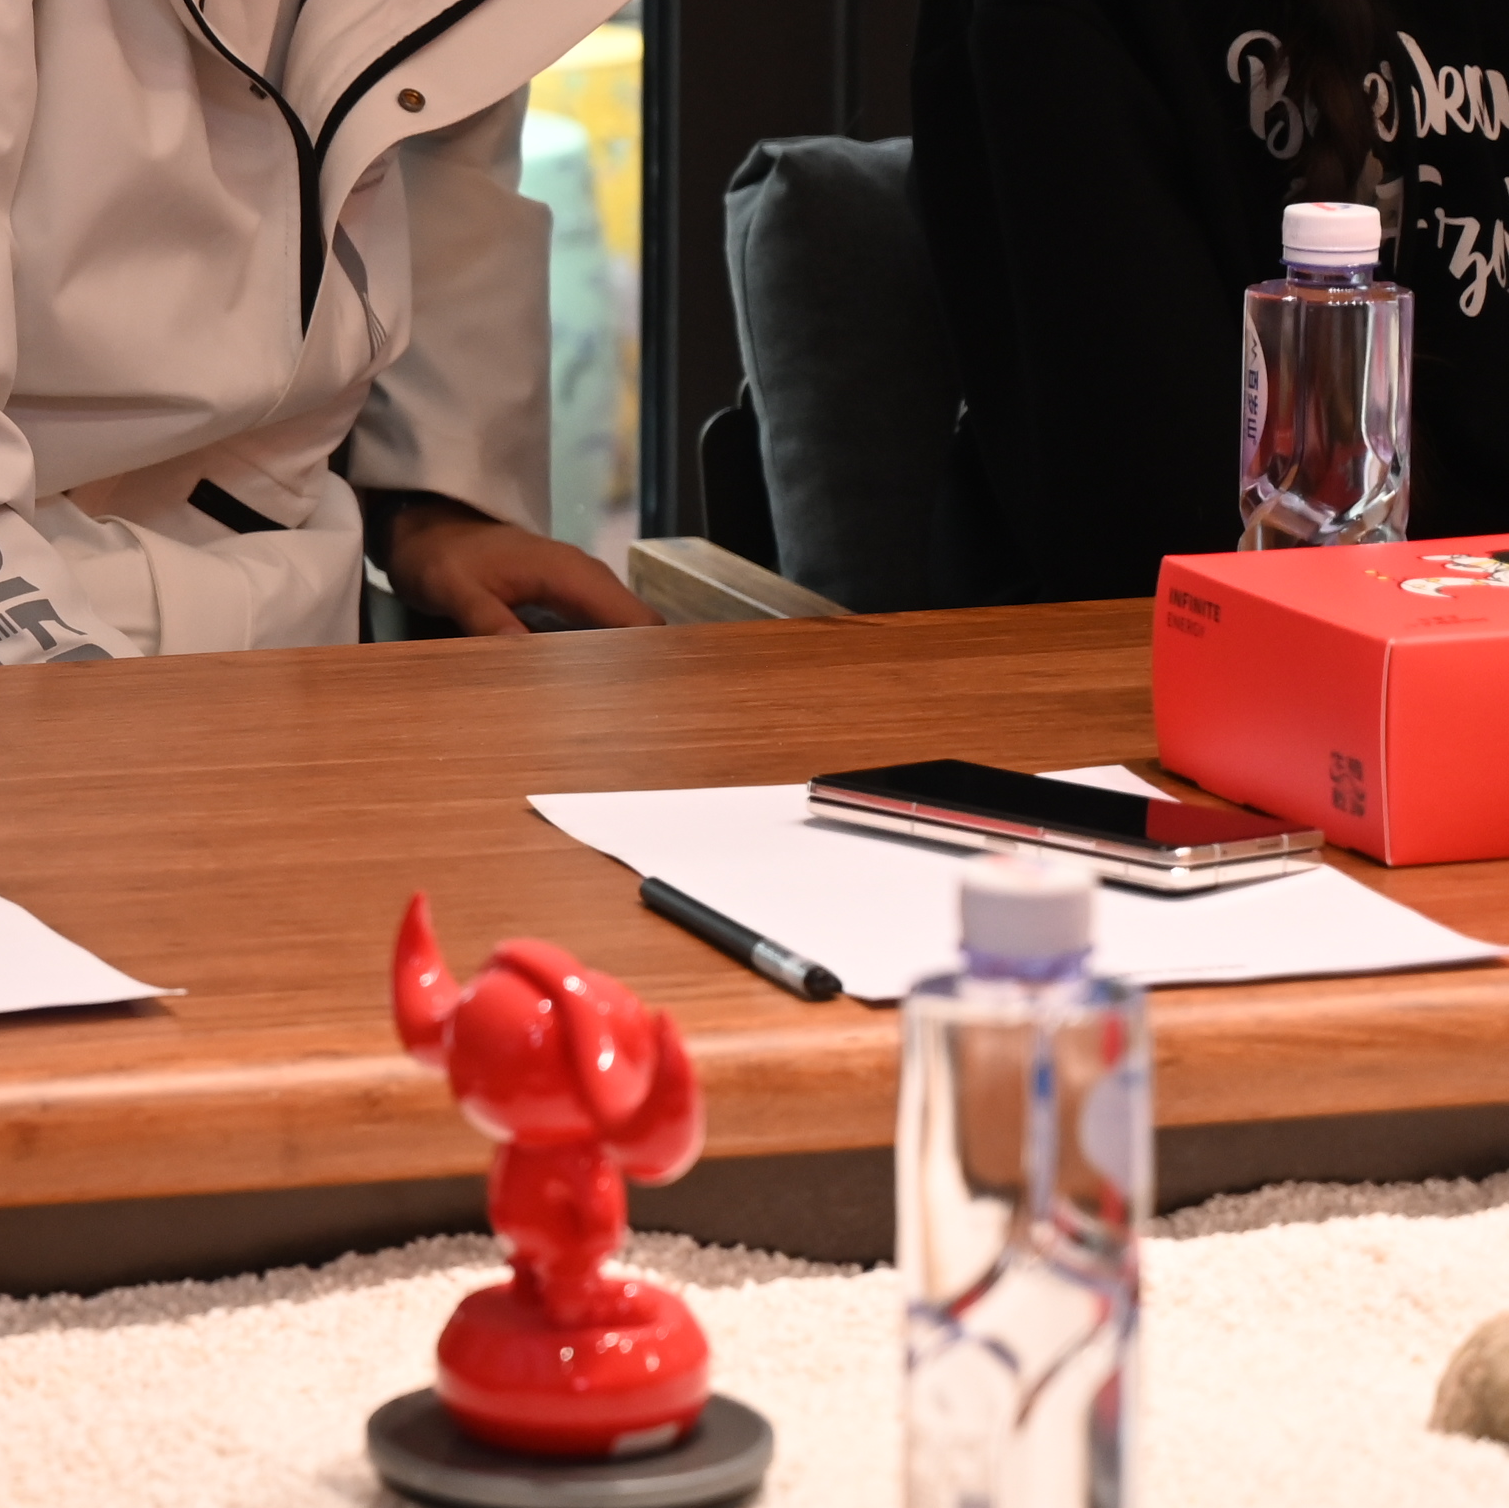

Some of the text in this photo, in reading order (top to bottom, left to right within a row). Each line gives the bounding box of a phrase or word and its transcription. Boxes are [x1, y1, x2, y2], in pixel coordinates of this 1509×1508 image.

[1247, 369, 1259, 439] 百岁山
[1168, 587, 1221, 623] INFINITE
